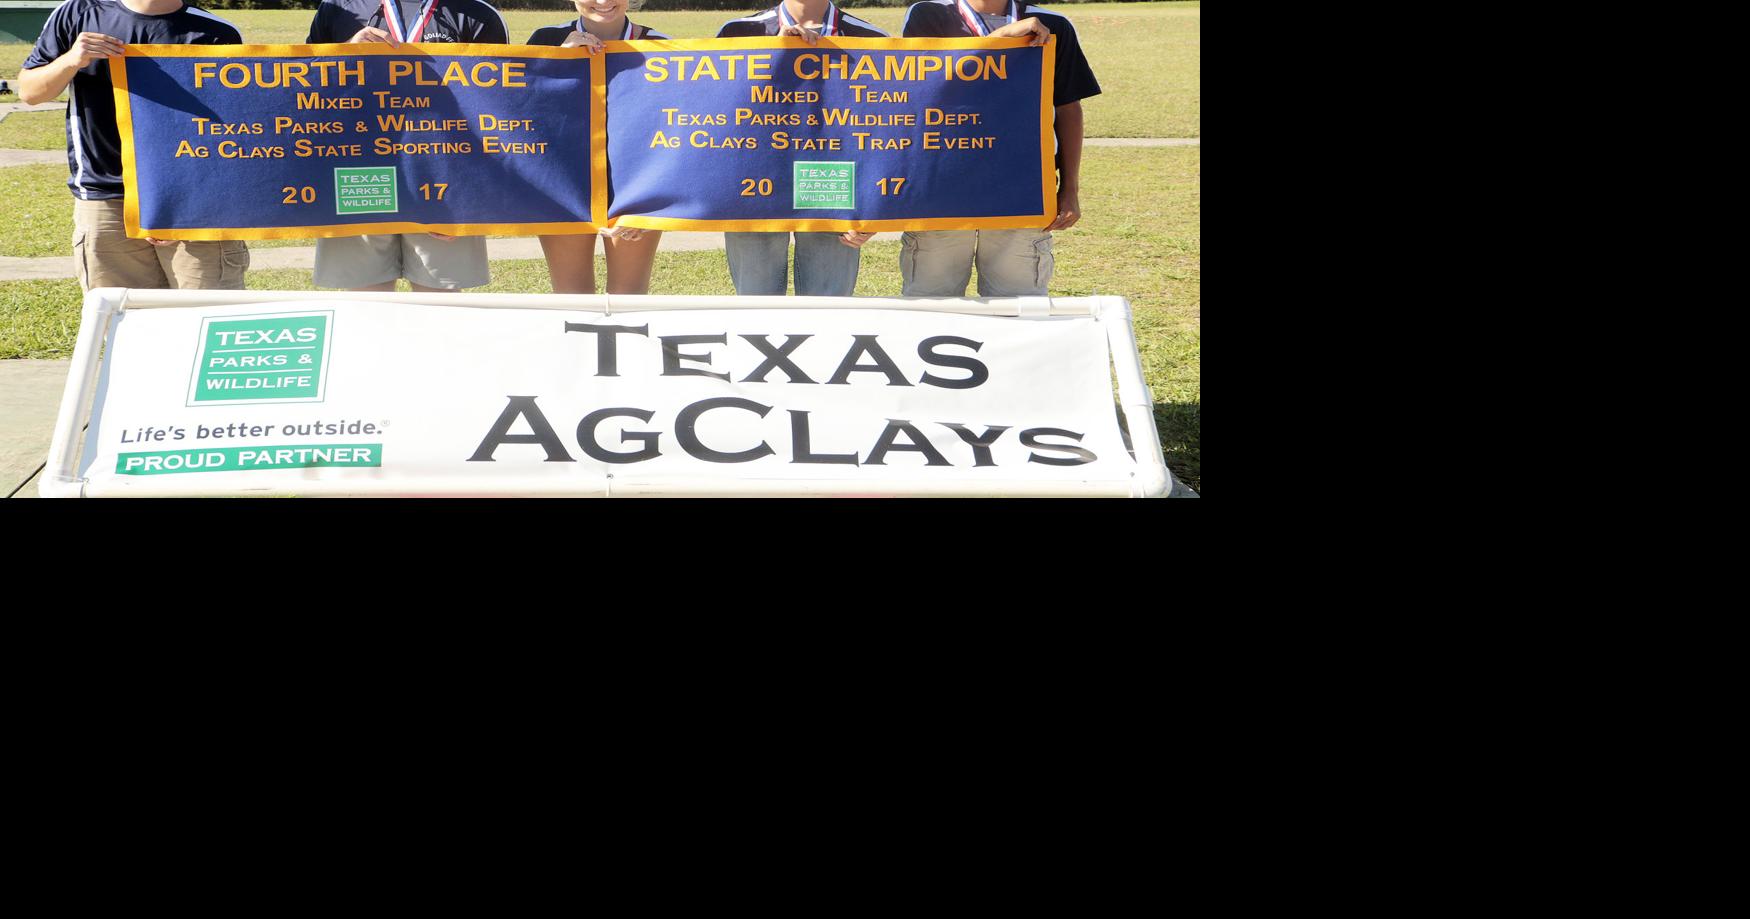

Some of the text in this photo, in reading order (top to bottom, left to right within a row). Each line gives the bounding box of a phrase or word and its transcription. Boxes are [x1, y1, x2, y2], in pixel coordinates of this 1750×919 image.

[193, 61, 527, 89] FOURTH PLACE
[644, 53, 1008, 83] STATE CHAMPION
[296, 91, 430, 110] MIXED TEAM
[750, 85, 908, 103] MIXED TEAM
[192, 114, 535, 136] TEXAS PARKS & WILDLIFE DEPT.
[662, 108, 982, 126] TEXAS PARKS & WILDLIFE DEPT.
[175, 136, 548, 159] AG CLAYS STATE SPORTING EVENT
[650, 130, 996, 151] AG CLAYS STATE TRAP EVENT
[340, 174, 391, 184] TEXAS
[800, 168, 849, 179] TEXAS
[282, 183, 448, 205] 20 17
[341, 186, 391, 197] PARKS &
[741, 178, 906, 197] 20 17
[799, 181, 849, 191] PARKS &
[342, 197, 392, 208] WILDLIFE
[800, 193, 849, 202] WILDLIFE
[216, 327, 317, 346] TEXAS
[209, 353, 313, 368] PARKS &
[564, 321, 988, 390] TEXAS
[206, 376, 312, 390] WILDLIFE
[120, 425, 185, 444] Life's
[196, 423, 274, 440] better
[125, 449, 372, 471] PROUD PARTNER
